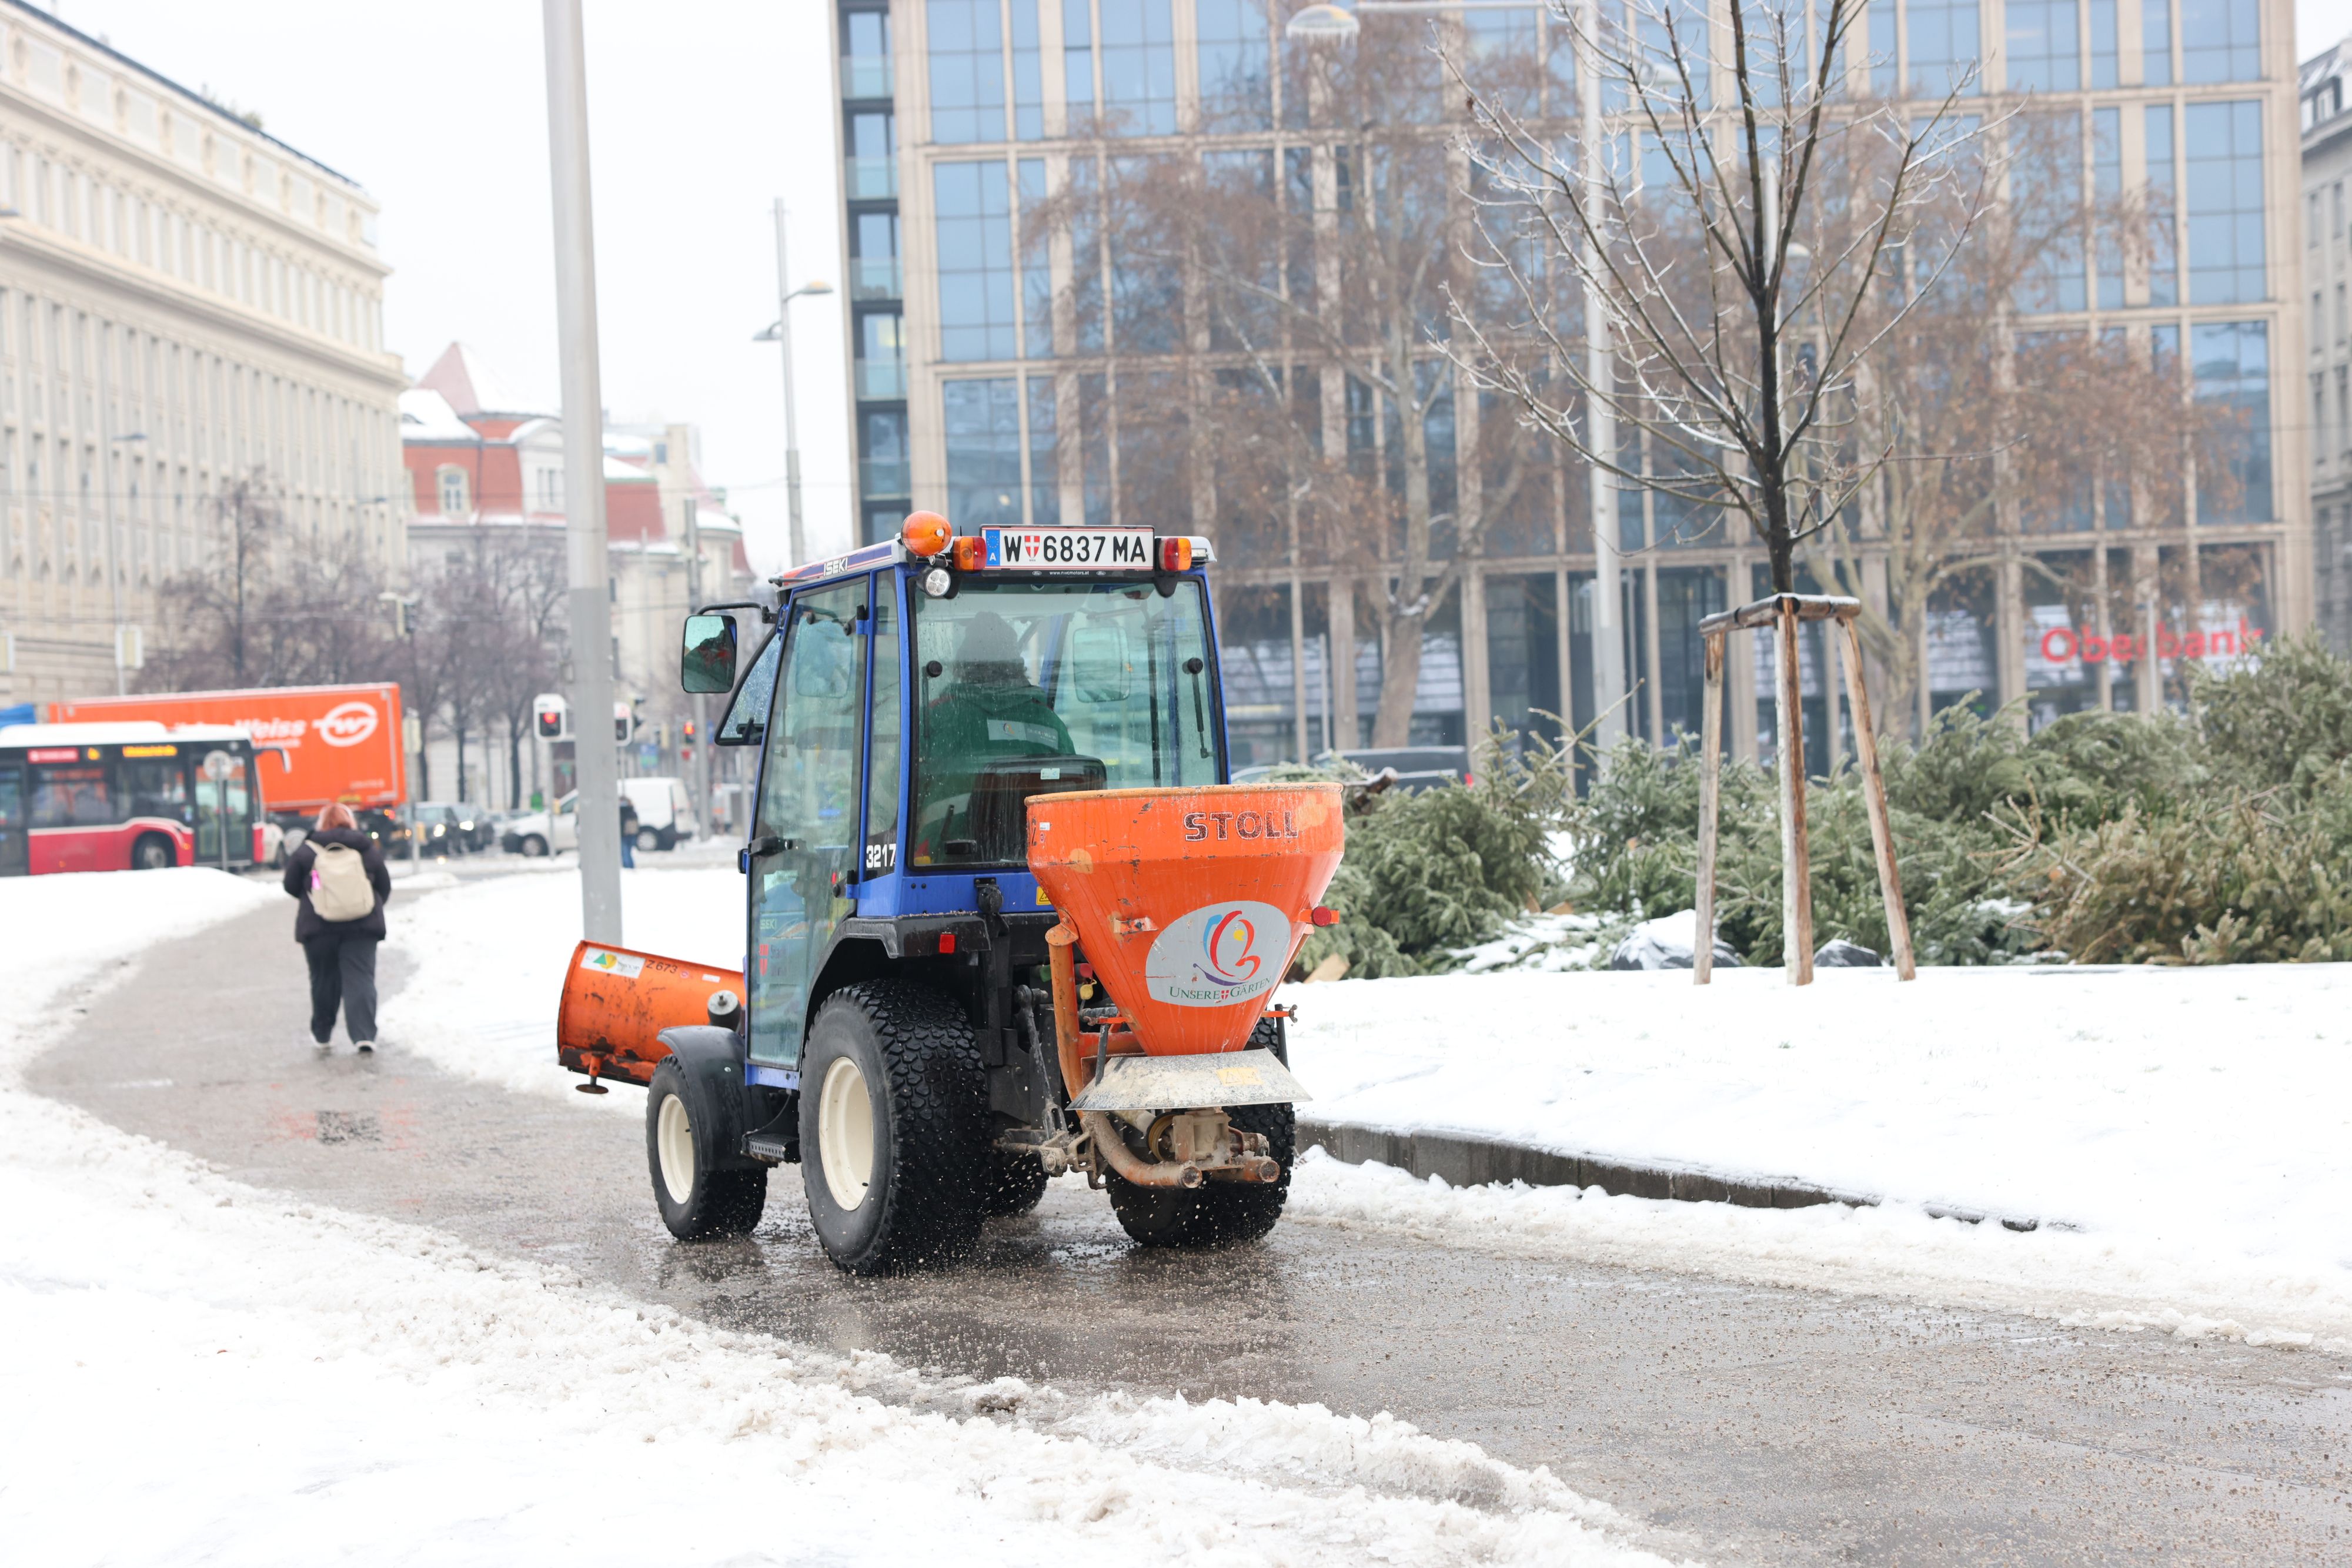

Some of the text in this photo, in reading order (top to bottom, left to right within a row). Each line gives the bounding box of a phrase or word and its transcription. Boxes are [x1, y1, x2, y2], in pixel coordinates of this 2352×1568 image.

[989, 552, 997, 561] A
[1004, 536, 1146, 563] W 6837 MA
[823, 556, 848, 576] ISEKI
[1183, 810, 1299, 841] STOLL
[866, 843, 897, 868] 3217
[646, 959, 656, 969] Z
[656, 962, 678, 974] 673
